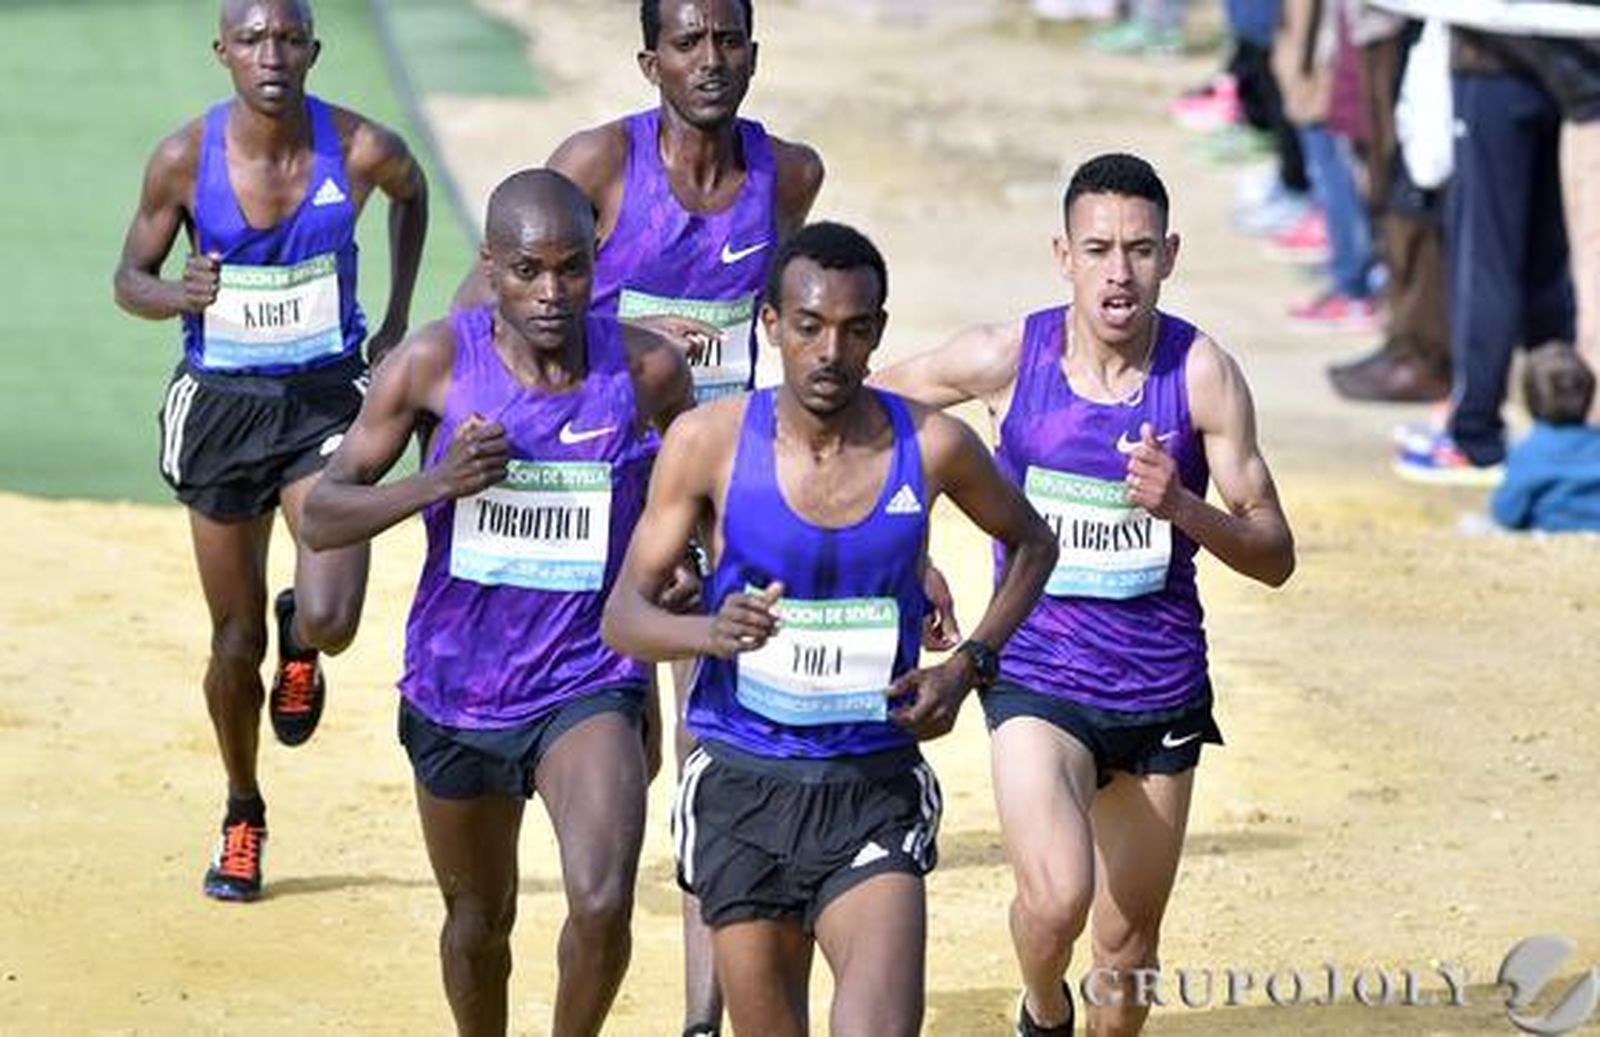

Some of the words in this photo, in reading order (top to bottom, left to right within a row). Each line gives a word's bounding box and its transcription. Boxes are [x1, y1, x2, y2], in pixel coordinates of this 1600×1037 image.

[244, 299, 302, 328] KIBET
[543, 468, 559, 484] DE
[561, 469, 606, 484] SEVILLA
[477, 499, 590, 540] TOROITICH
[825, 607, 843, 625] DE
